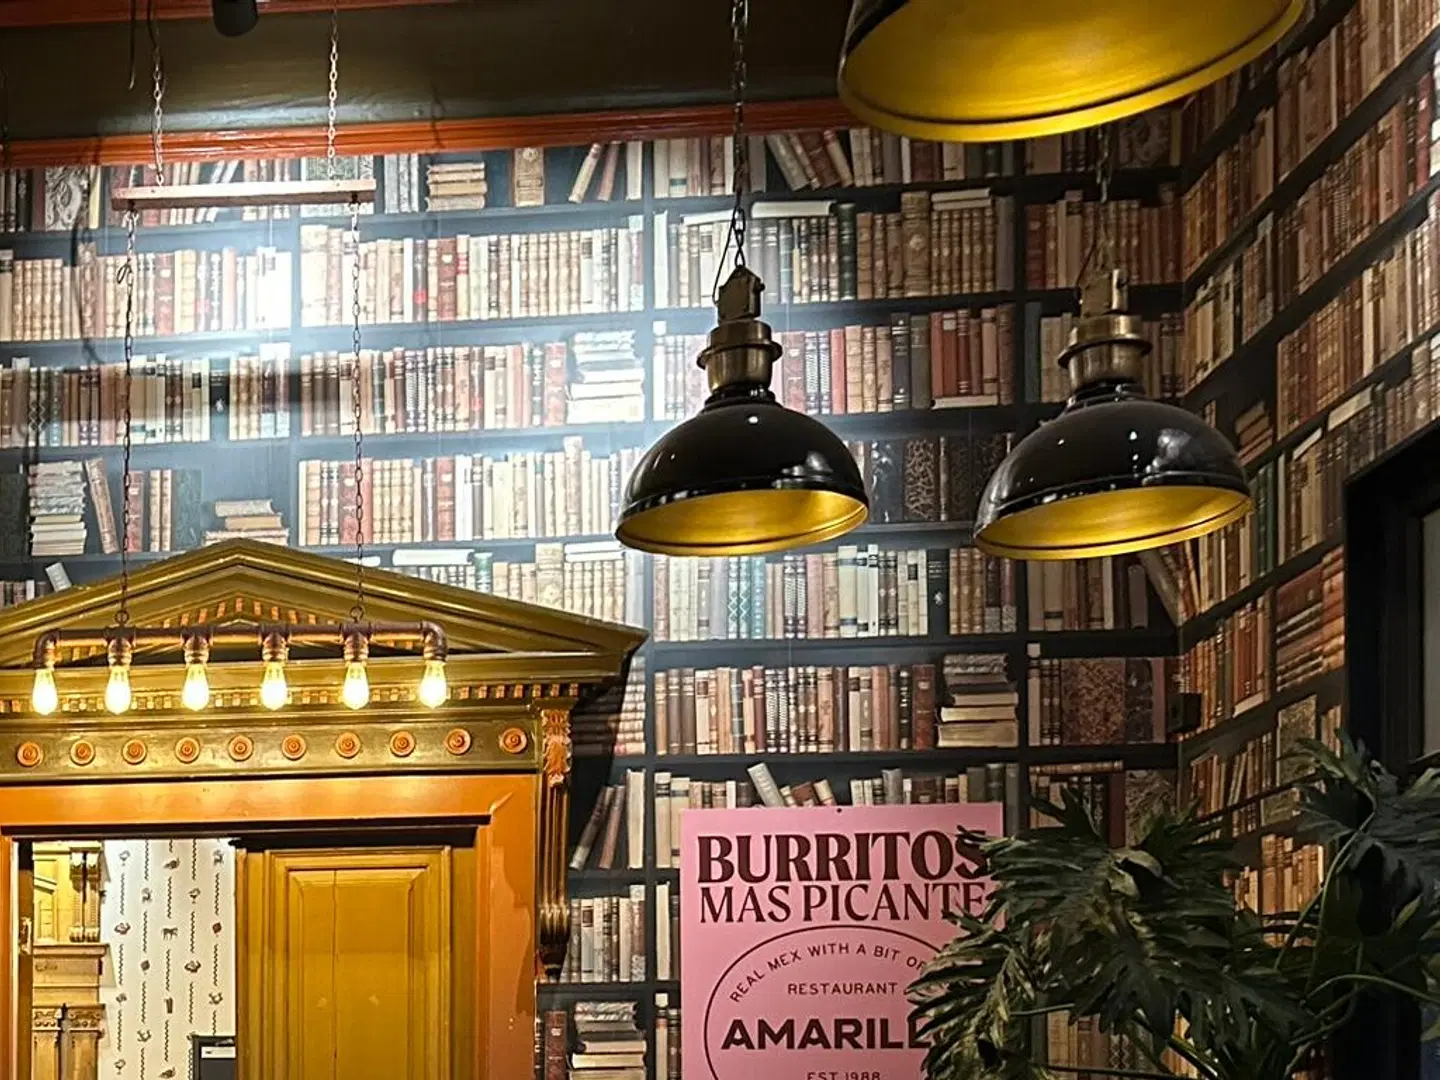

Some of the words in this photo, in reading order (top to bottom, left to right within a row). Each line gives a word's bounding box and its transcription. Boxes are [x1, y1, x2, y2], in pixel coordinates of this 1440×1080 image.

[697, 830, 991, 884] BURRITOS
[700, 885, 792, 923] MAS
[802, 881, 986, 922] PICANTE
[729, 969, 766, 1003] REAL
[766, 948, 802, 972] MEX
[807, 942, 850, 958] WITH
[855, 943, 867, 955] A
[873, 945, 901, 962] BIT
[787, 981, 899, 996] RESTAURANT
[721, 1017, 932, 1050] AMARILL
